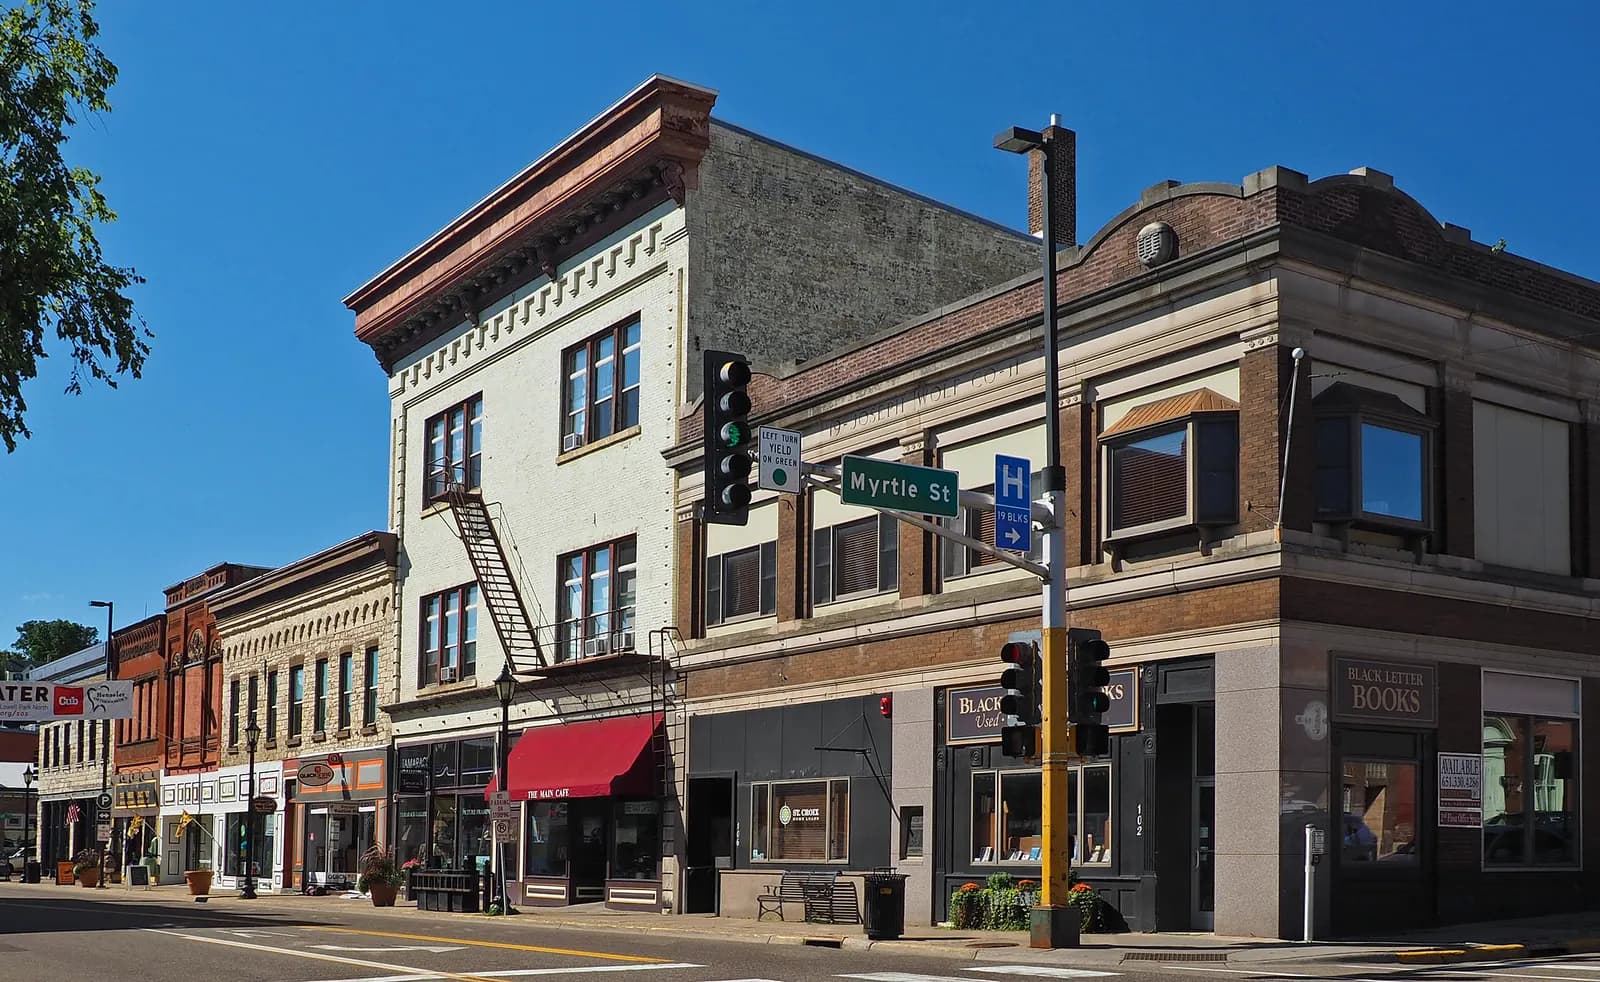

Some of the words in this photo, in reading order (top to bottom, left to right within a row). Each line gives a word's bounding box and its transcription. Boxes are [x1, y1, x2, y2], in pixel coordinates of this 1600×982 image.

[762, 431, 778, 440] LEFT
[782, 434, 798, 444] TURN
[770, 442, 792, 455] YIELD
[762, 455, 772, 463] ON
[775, 457, 798, 467] GREEN
[851, 471, 918, 498] Myrtle
[929, 483, 950, 502] St
[1003, 464, 1023, 499] H
[997, 511, 1006, 520] 19
[1007, 512, 1028, 524] BLKS
[1348, 667, 1382, 682] BLACK
[1385, 671, 1424, 686] LETTER
[960, 696, 1003, 715] BLACK
[1352, 684, 1420, 713] BOOKS
[975, 712, 1001, 728] Used
[1441, 759, 1480, 775] AVAILABLE
[102, 796, 110, 805] P
[528, 790, 538, 799] THE
[540, 789, 553, 798] MAIN
[555, 788, 570, 797] CAFE
[801, 808, 819, 816] CROIX
